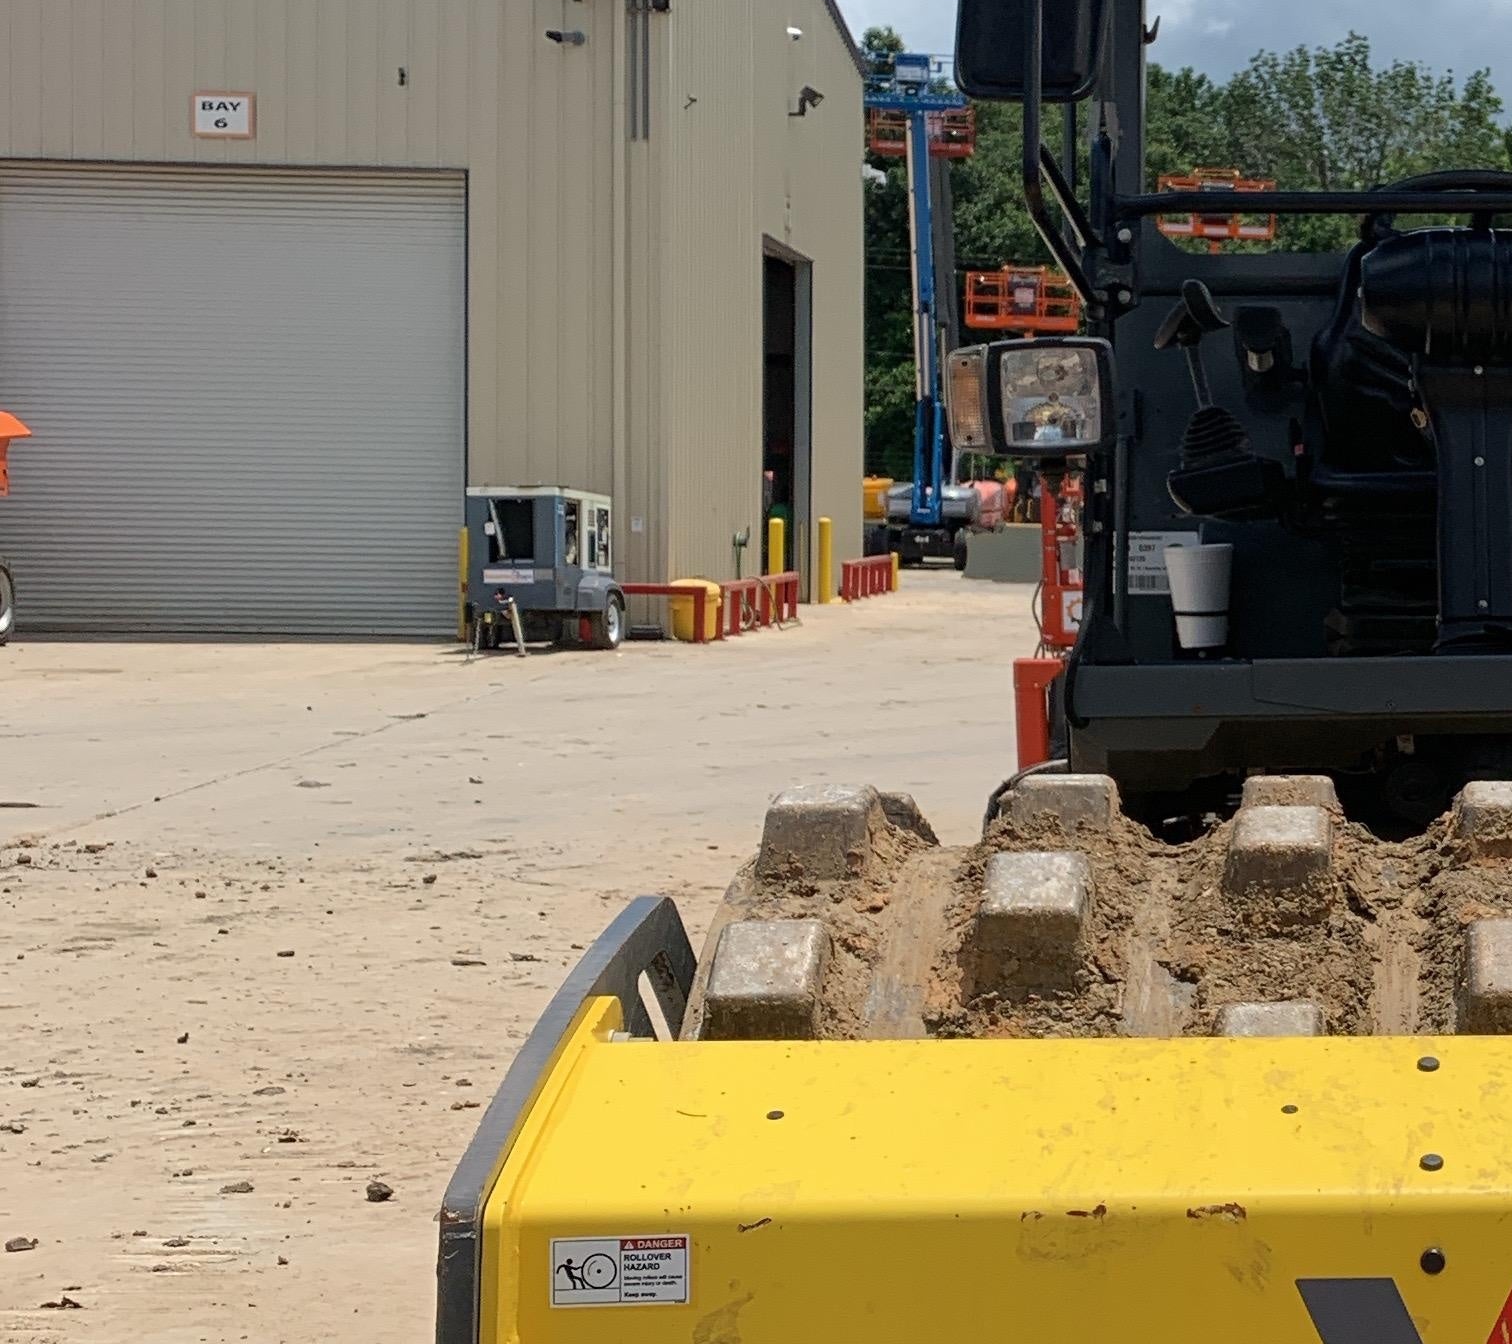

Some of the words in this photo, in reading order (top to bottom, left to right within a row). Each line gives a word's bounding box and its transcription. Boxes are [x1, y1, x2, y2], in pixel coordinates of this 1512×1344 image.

[201, 100, 241, 112] BAY
[214, 117, 228, 129] 6
[637, 1239, 683, 1249] DANGER
[624, 1253, 672, 1262] ROLLOVER
[624, 1263, 660, 1271] HAZARD
